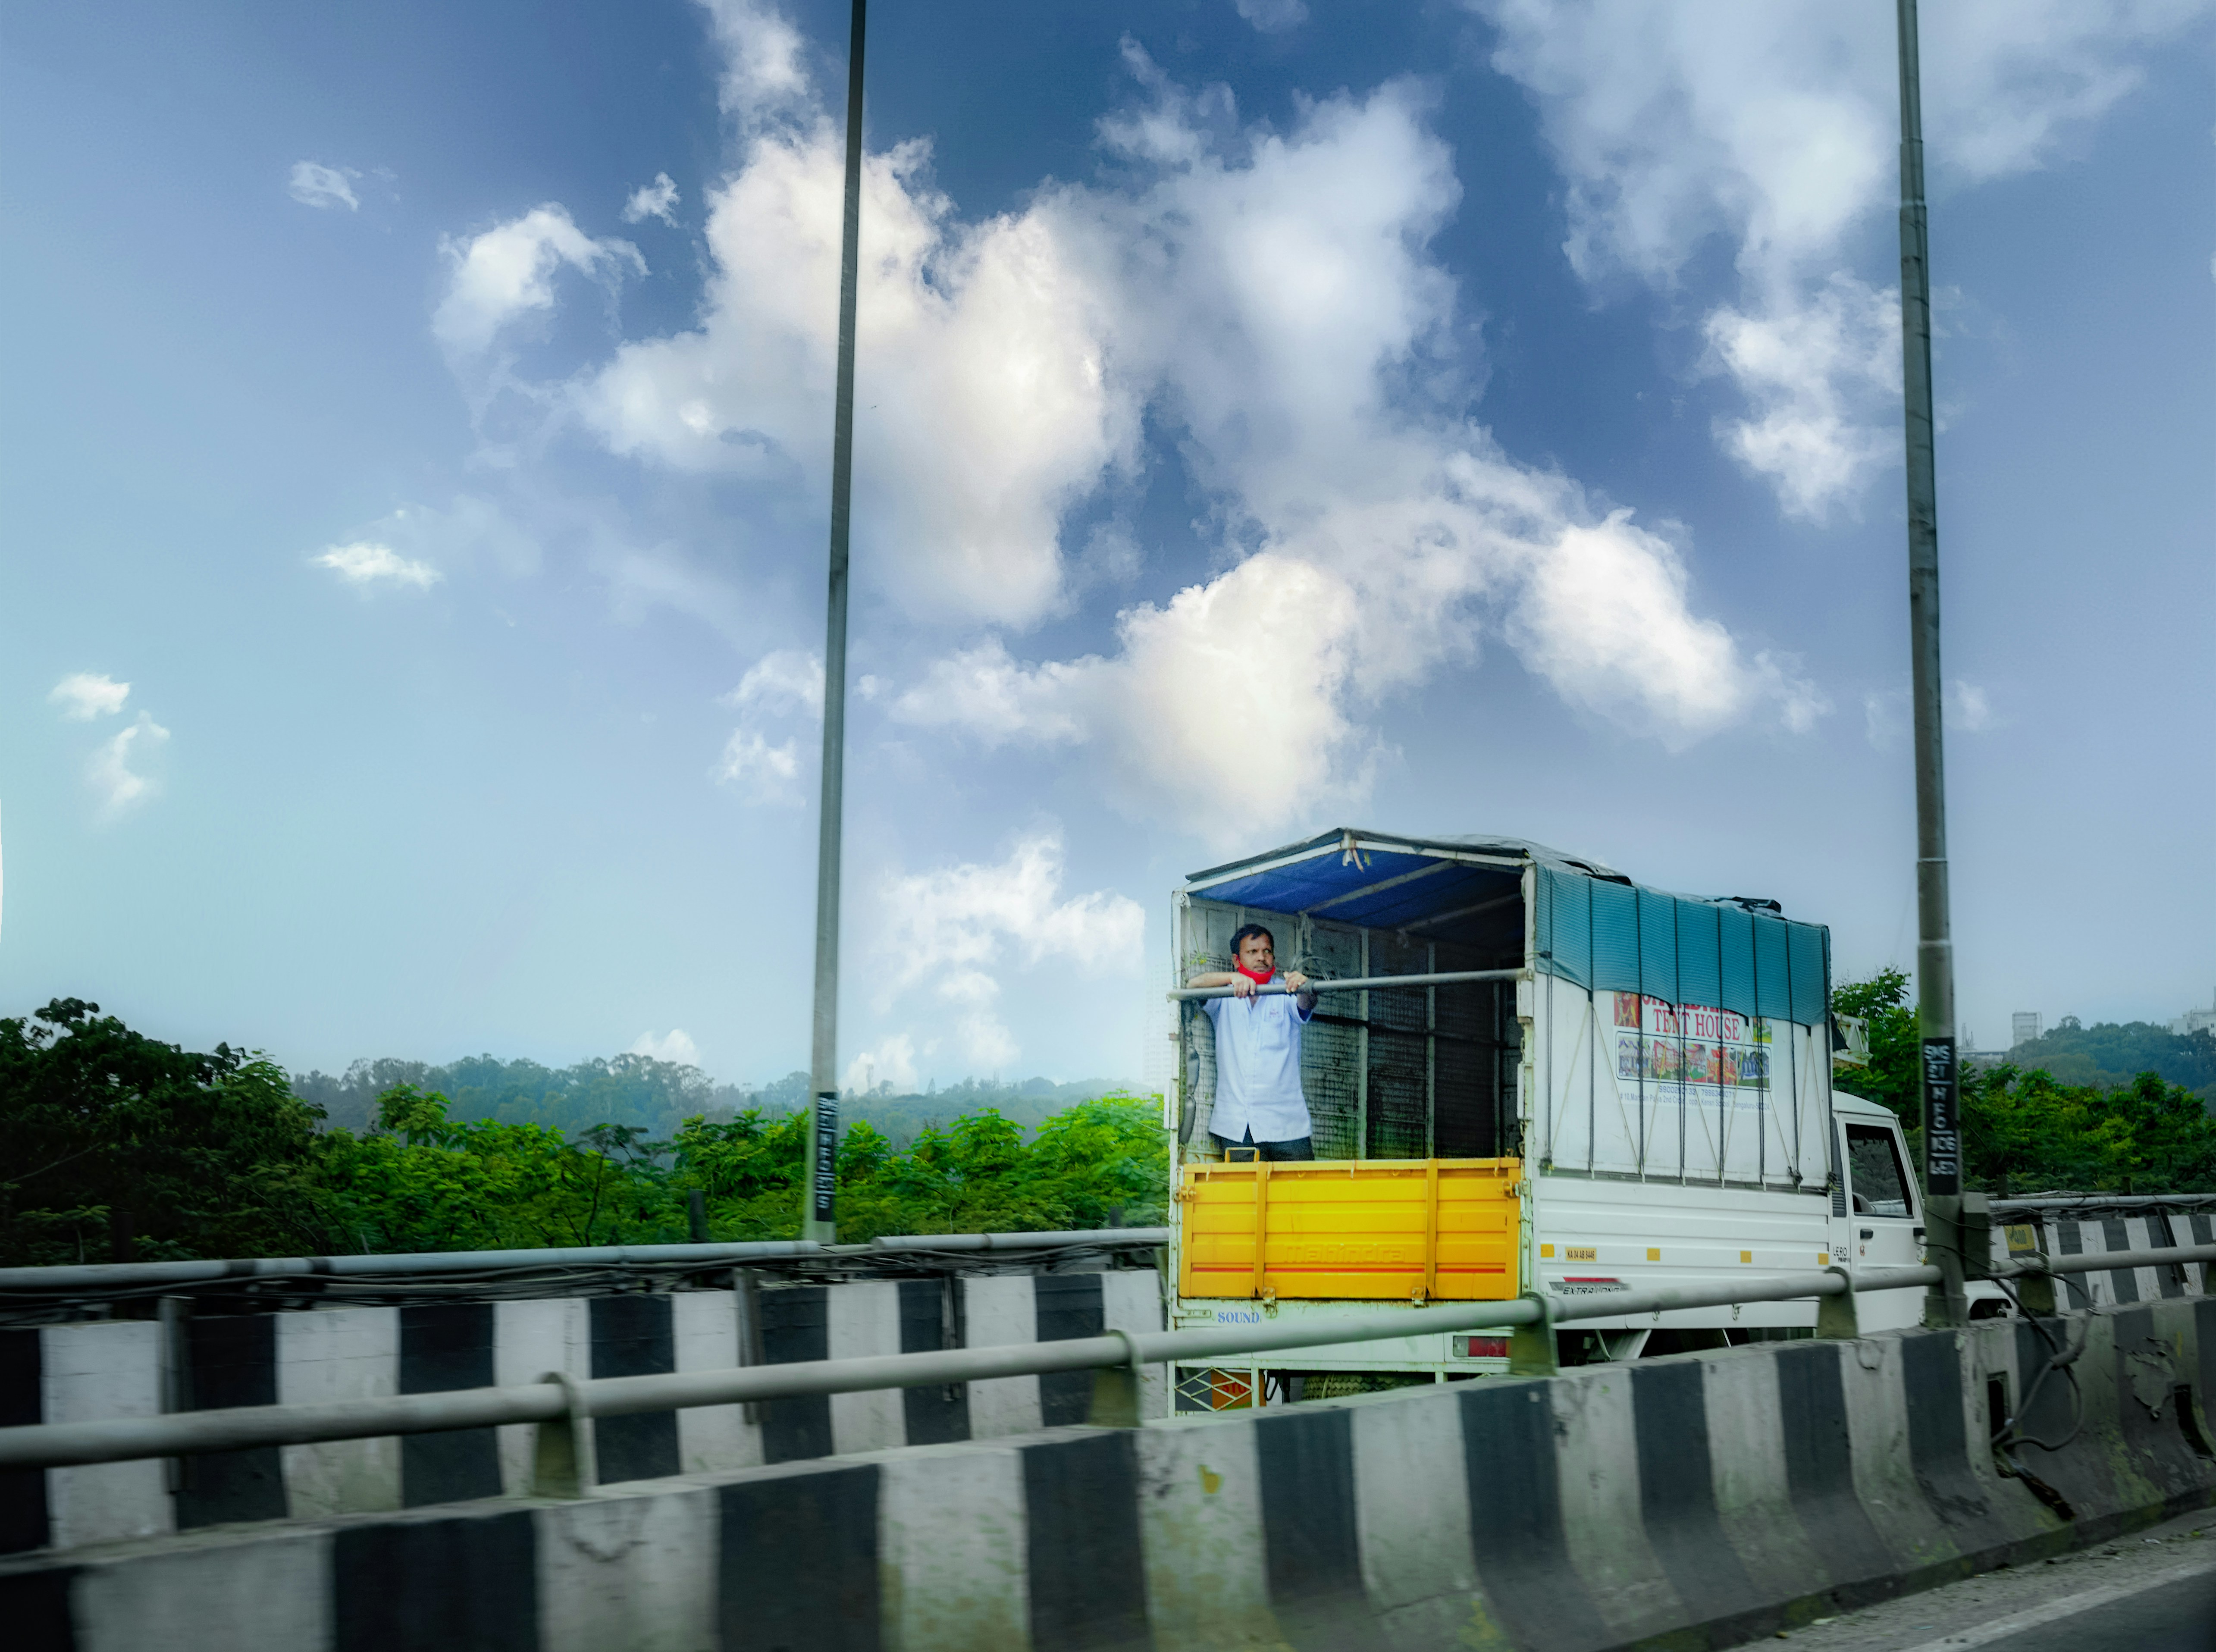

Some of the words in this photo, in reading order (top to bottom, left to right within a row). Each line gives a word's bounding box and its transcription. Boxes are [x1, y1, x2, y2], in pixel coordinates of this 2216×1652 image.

[1653, 1009, 1690, 1035] TENT
[1695, 1013, 1740, 1041] HOUSE
[1567, 1250, 1573, 1258] KA
[1574, 1250, 1578, 1258] 04
[1580, 1250, 1585, 1259] AB
[1563, 1287, 1594, 1295] EXTRA
[1217, 1311, 1260, 1324] SOUND
[1221, 1379, 1252, 1395] STO
